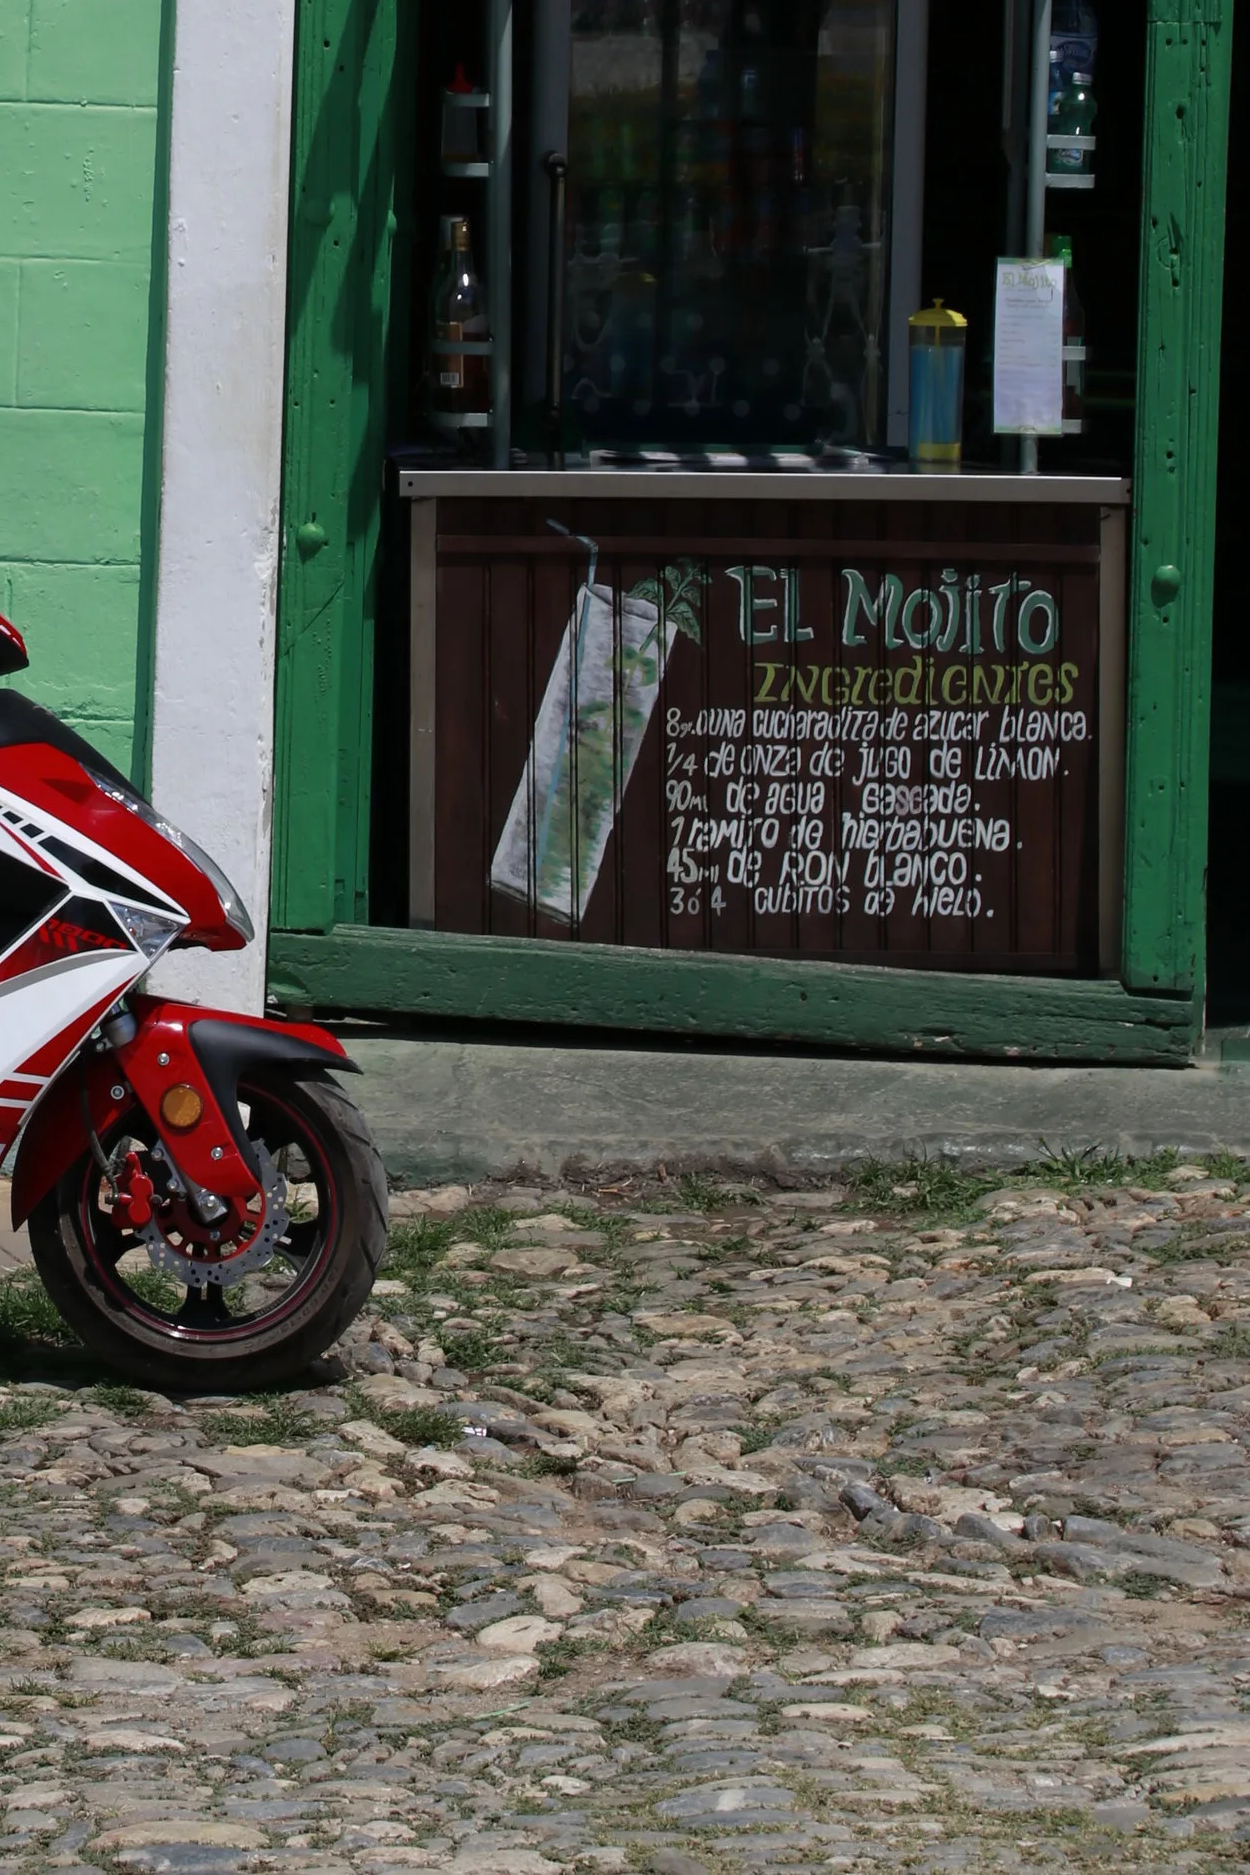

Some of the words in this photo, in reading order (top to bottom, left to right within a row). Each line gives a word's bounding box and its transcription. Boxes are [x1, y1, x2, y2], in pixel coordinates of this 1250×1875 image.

[724, 565, 815, 644] EL
[880, 706, 909, 741] de
[666, 742, 699, 777] 1/4
[704, 741, 735, 778] de
[809, 742, 845, 777] de
[929, 741, 962, 779] de
[726, 776, 760, 814] de
[790, 815, 824, 850] de
[727, 846, 762, 888] de
[864, 887, 896, 916] de
